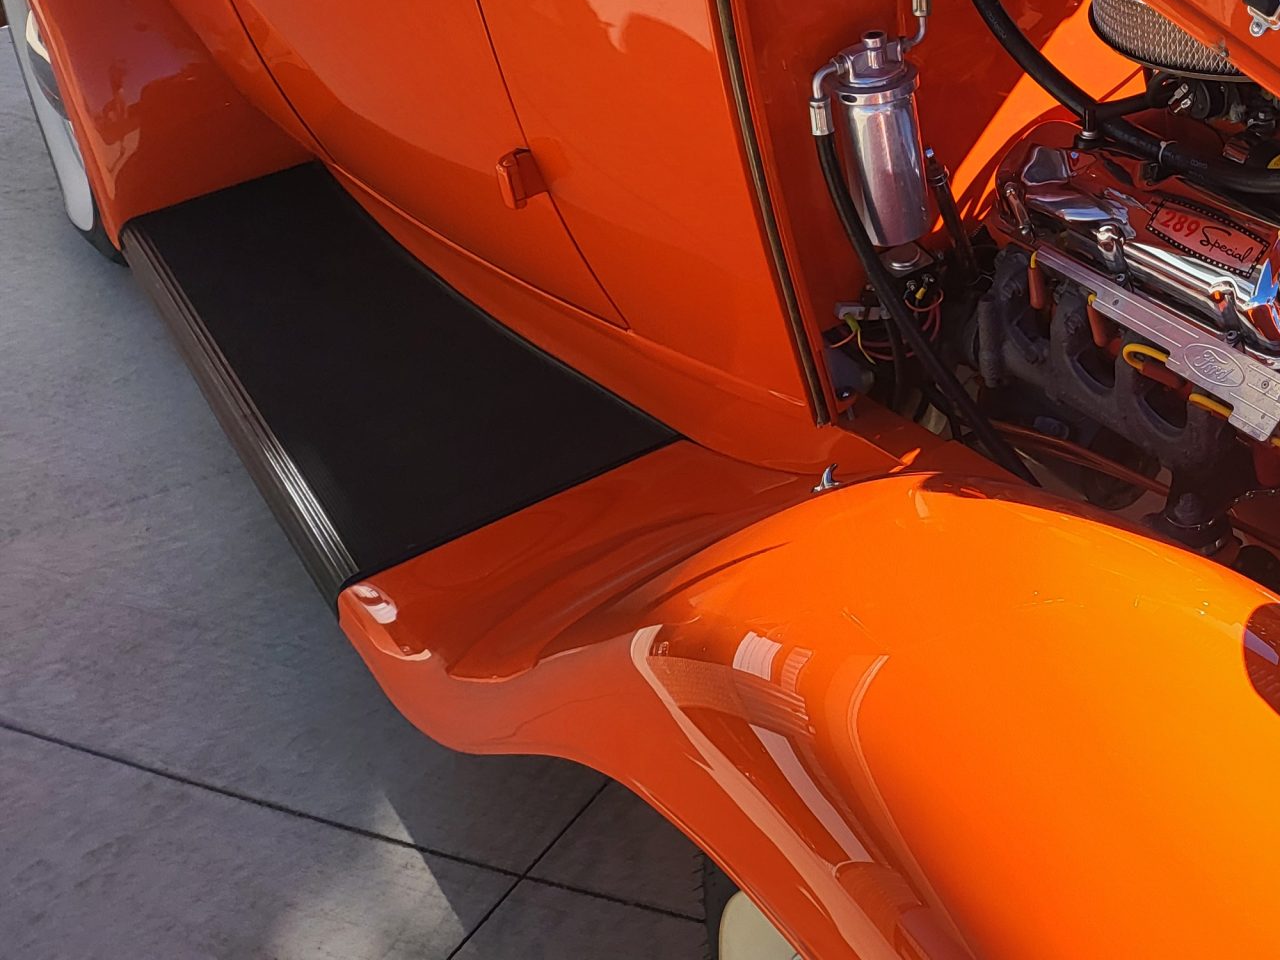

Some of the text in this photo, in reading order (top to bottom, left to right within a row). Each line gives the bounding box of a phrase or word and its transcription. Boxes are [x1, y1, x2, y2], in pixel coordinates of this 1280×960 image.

[1160, 210, 1254, 263] 289 Special
[1193, 349, 1236, 383] Ford
